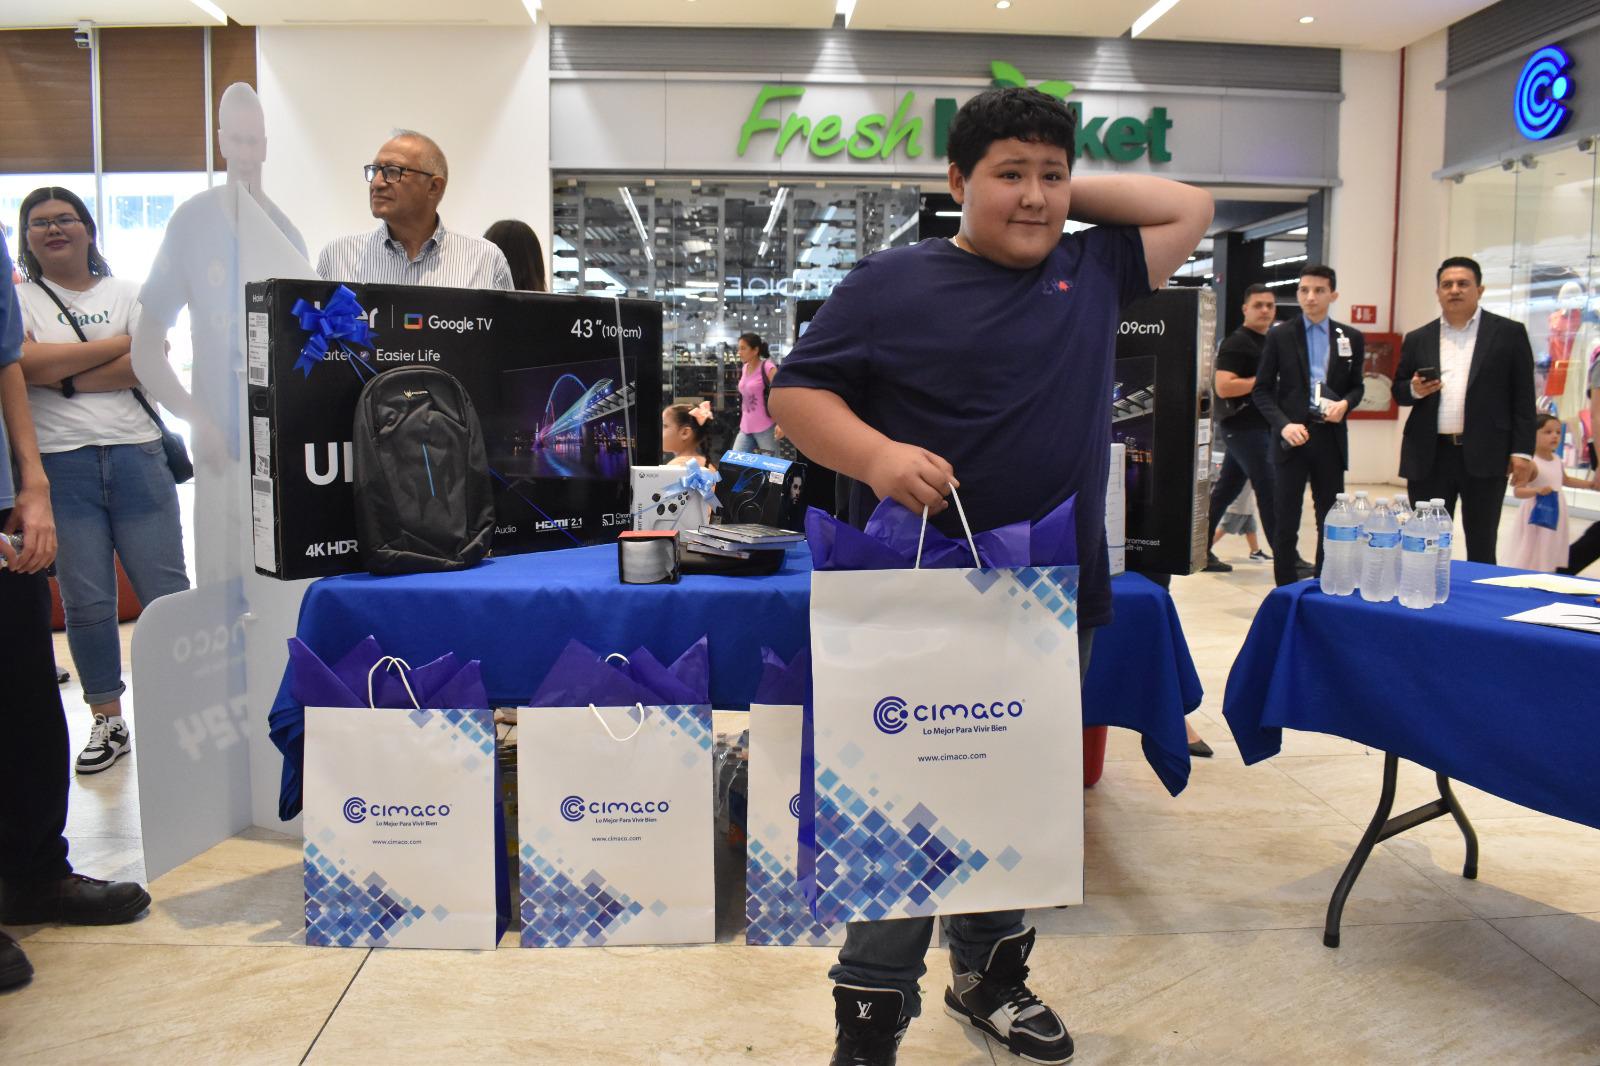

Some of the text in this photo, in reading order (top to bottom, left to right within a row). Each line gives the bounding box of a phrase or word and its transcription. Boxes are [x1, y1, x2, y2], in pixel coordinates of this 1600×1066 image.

[737, 85, 924, 160] Fresh
[428, 315, 493, 334] Google TV
[1116, 319, 1166, 336] 09cm)
[602, 324, 642, 340] (109cm)
[376, 349, 414, 362] Easier
[418, 349, 441, 362] Life
[494, 524, 517, 535] Audio
[535, 517, 583, 530] HDMI 2.1
[304, 539, 359, 558] 4K HDR
[913, 700, 1023, 722] cimaco
[933, 727, 954, 736] Mejor
[956, 726, 973, 734] Para
[973, 725, 990, 733] Vivir
[991, 724, 1007, 732] Bien
[917, 752, 987, 763] www.cimaco.com
[370, 804, 450, 817] cimaco
[589, 801, 669, 814] cimaco
[603, 817, 618, 825] Mejor
